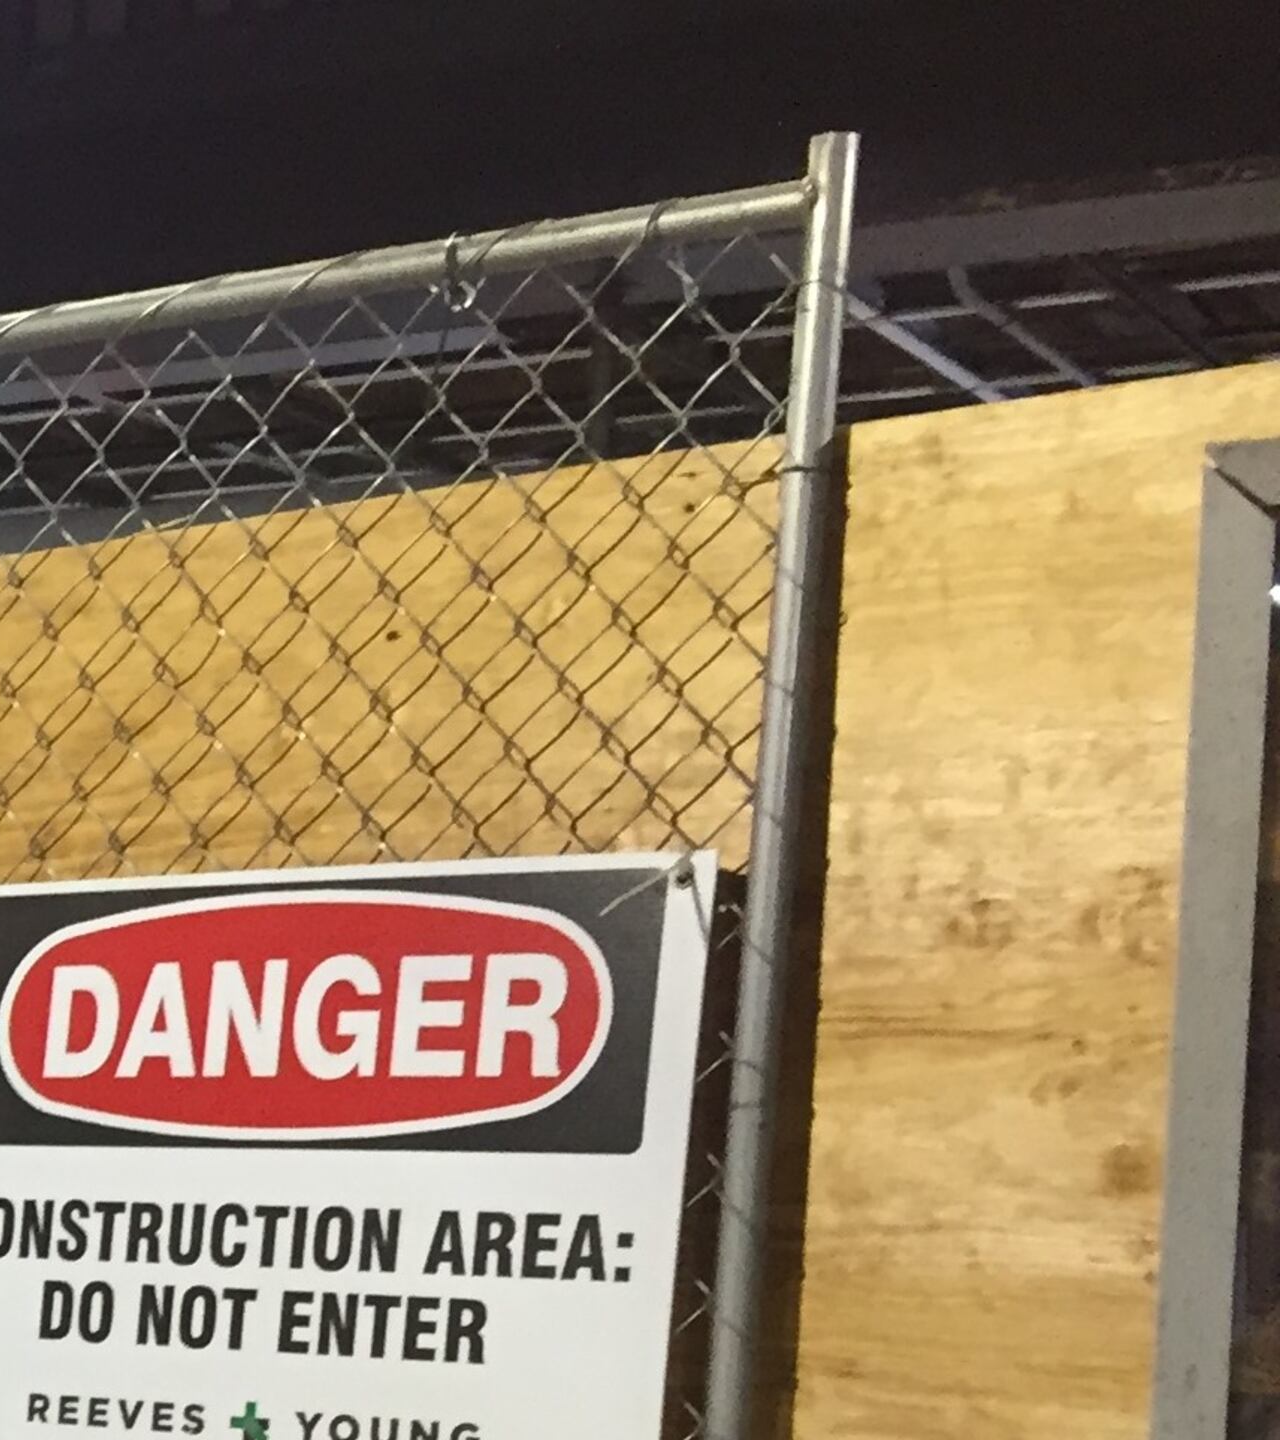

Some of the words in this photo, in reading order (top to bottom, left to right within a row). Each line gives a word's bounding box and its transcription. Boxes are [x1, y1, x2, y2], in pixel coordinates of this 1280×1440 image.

[41, 952, 571, 1081] DANGER
[423, 1210, 634, 1283] AREA:
[39, 1279, 114, 1345] DO
[136, 1284, 259, 1352] NOT
[277, 1291, 489, 1366] ENTER
[26, 1393, 206, 1436] REEVES
